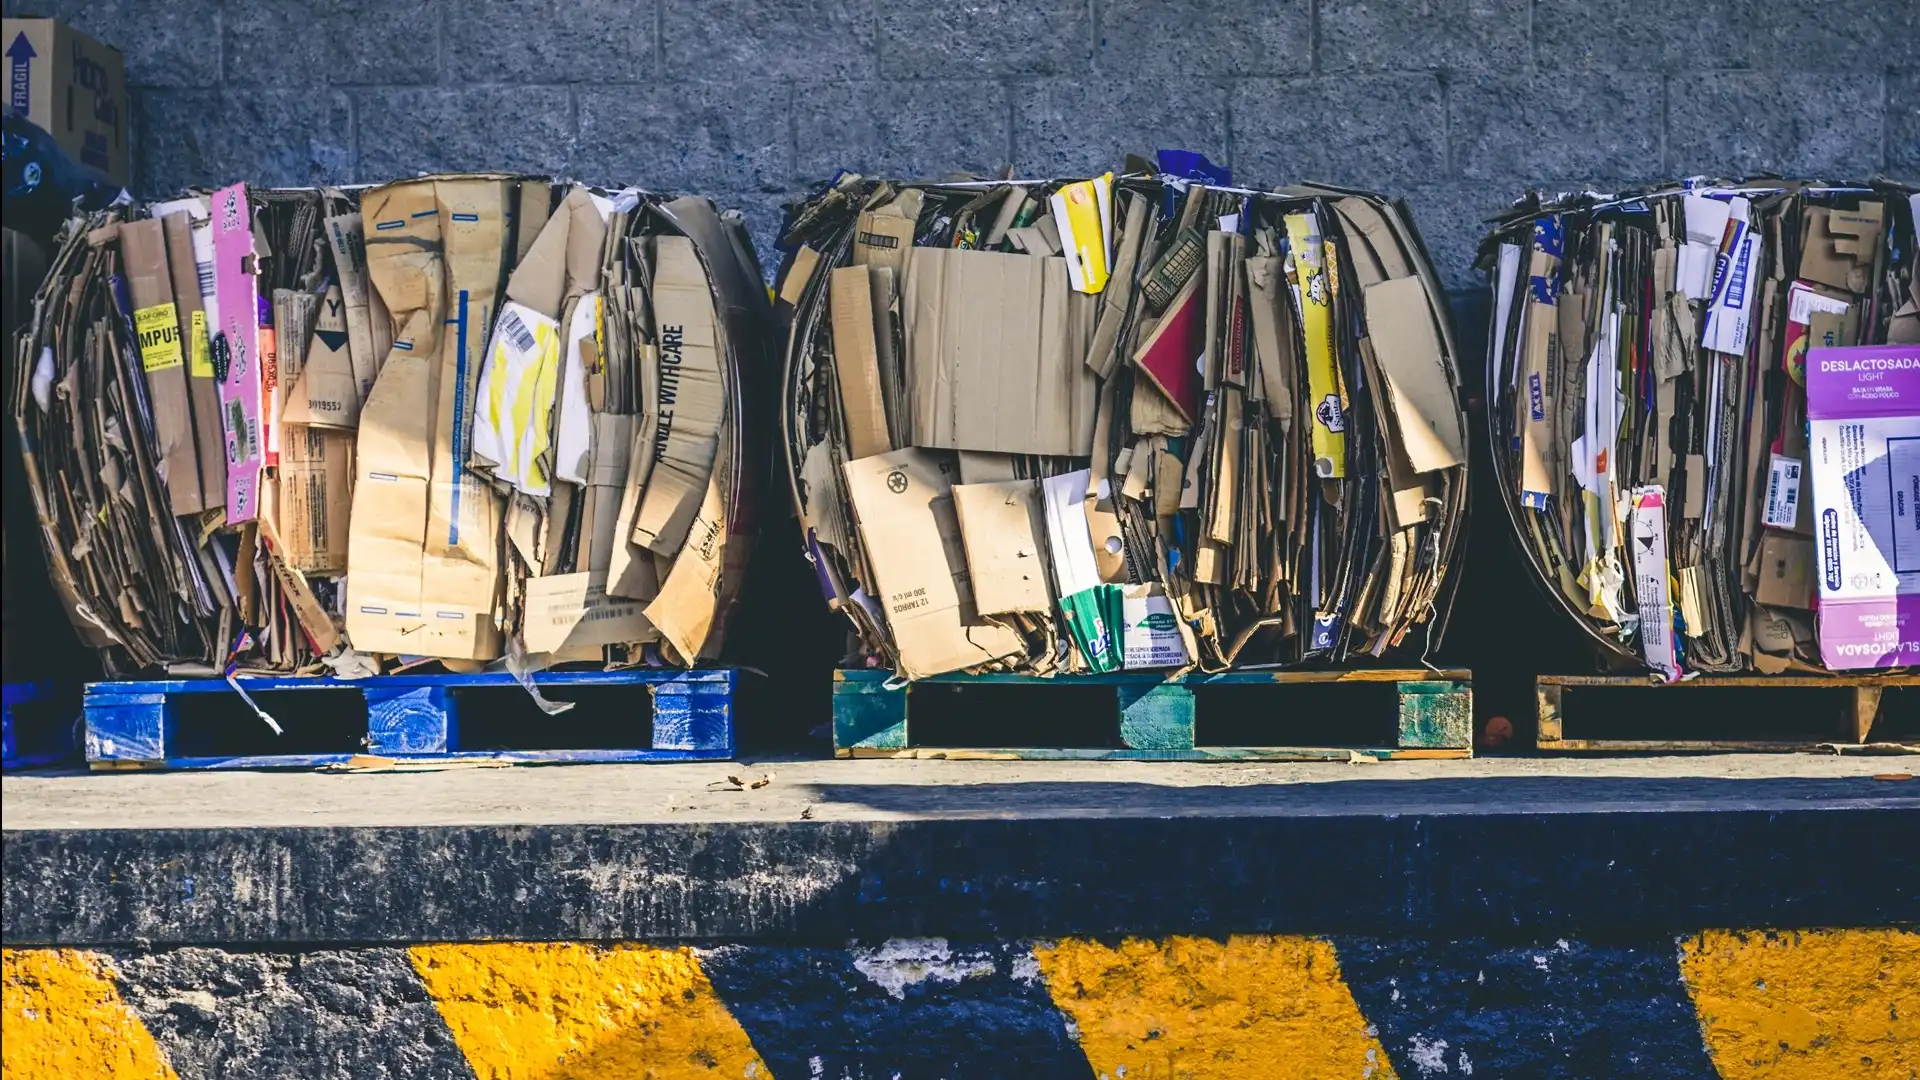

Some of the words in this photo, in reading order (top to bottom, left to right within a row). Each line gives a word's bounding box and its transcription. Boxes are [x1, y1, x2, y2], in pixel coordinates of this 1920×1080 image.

[14, 61, 28, 107] FRAGIL
[327, 298, 340, 317] Y
[1821, 358, 1920, 372] DESLACTOSADA
[1858, 372, 1884, 382] LIGHT
[700, 521, 718, 556] FIRST
[914, 588, 926, 597] 300
[893, 600, 920, 614] TARROS
[920, 598, 929, 607] 12
